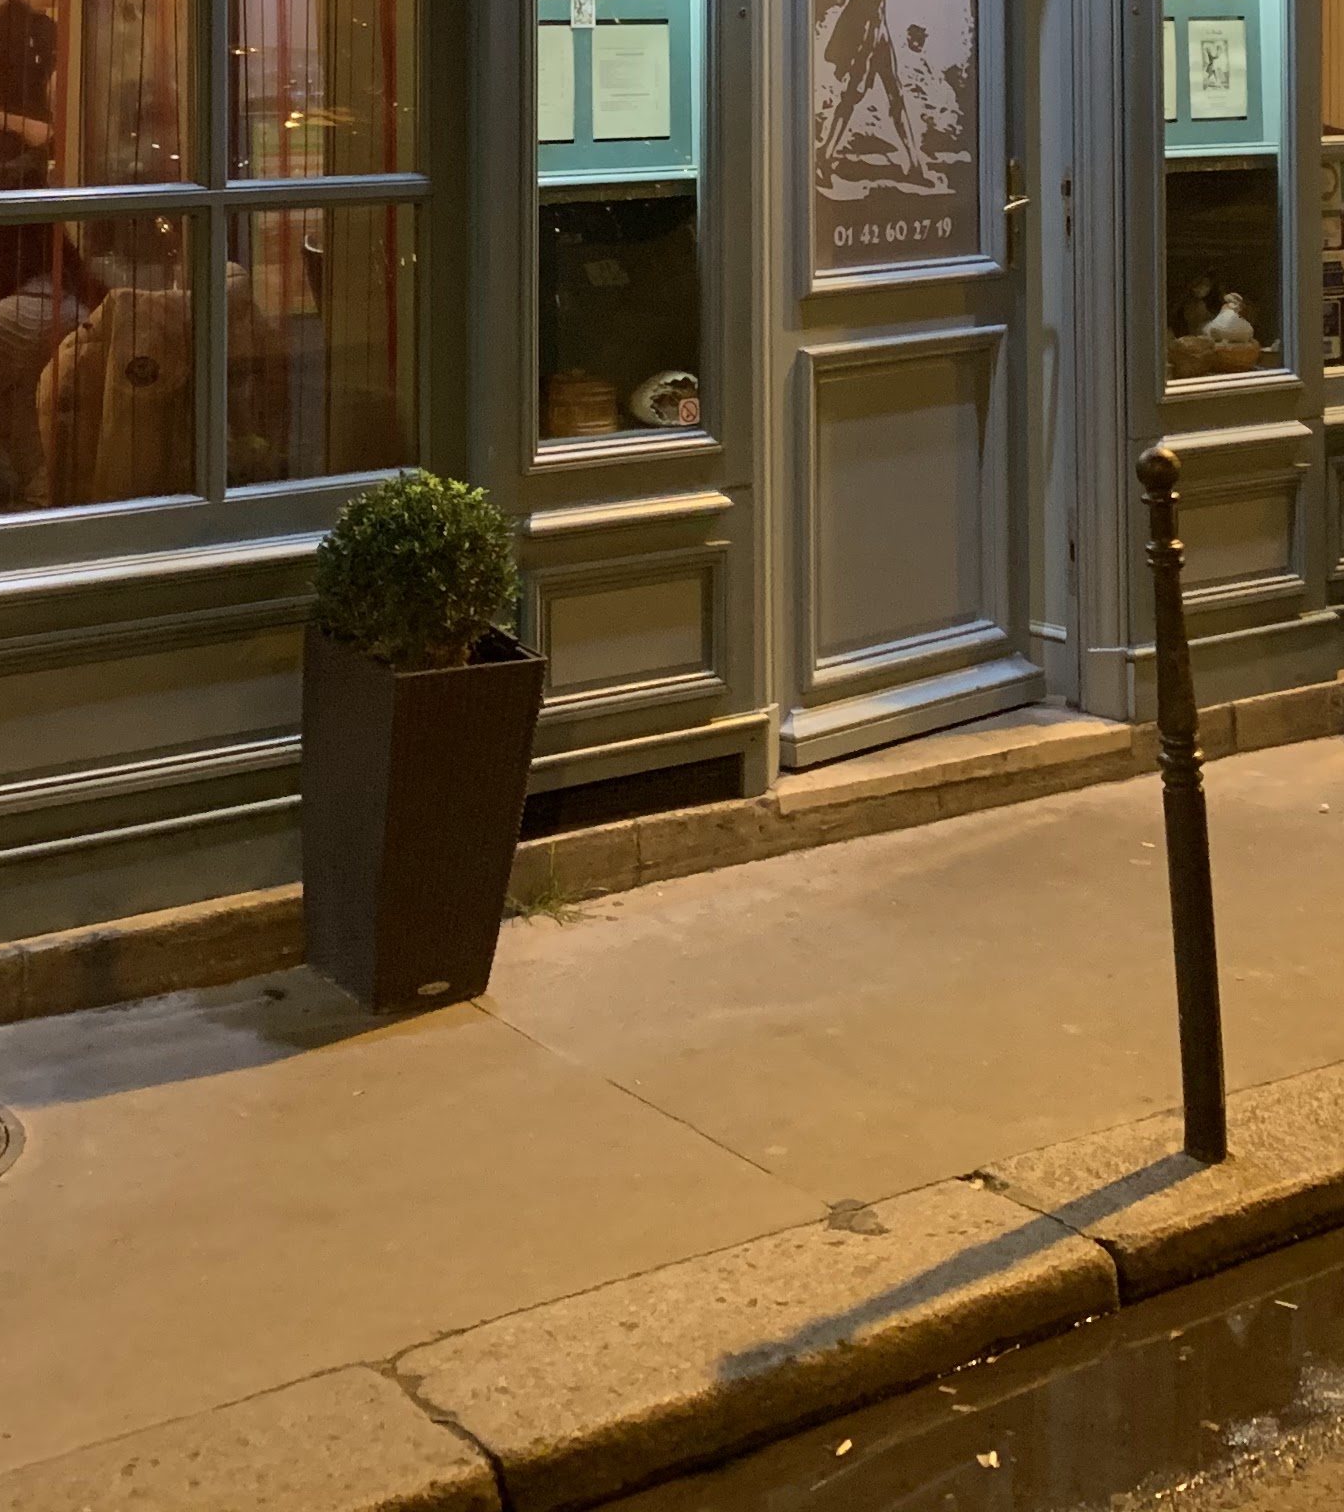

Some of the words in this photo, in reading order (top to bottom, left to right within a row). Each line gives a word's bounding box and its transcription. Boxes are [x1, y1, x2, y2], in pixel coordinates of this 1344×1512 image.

[833, 225, 853, 247] 01
[859, 223, 880, 245] 42
[885, 219, 908, 243] 60
[913, 218, 932, 241] 27
[935, 216, 952, 239] 19
